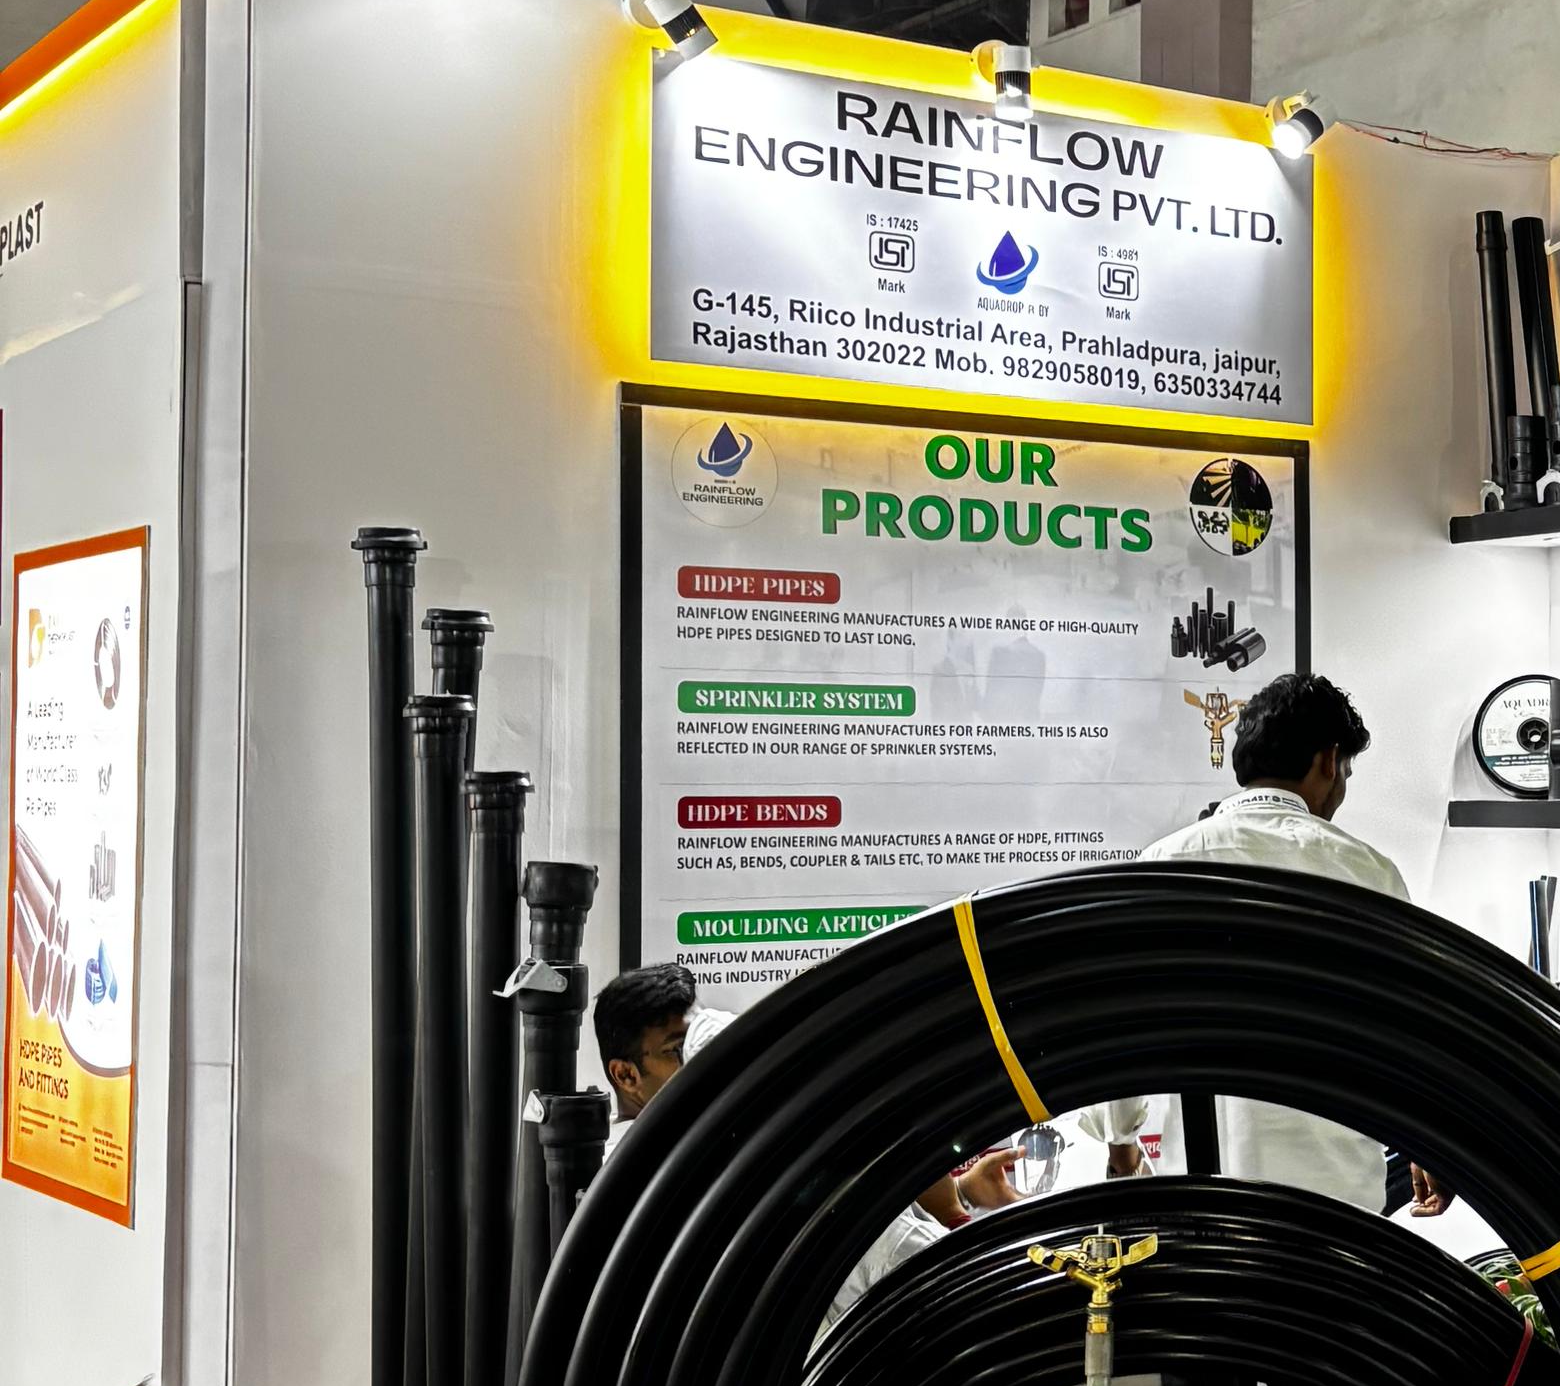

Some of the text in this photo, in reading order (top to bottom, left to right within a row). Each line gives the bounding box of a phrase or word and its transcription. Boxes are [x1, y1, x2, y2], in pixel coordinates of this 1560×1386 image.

[837, 90, 1164, 179] RAINFLOW
[695, 125, 1282, 245] ENGINEERING PVT. LTD.
[867, 214, 919, 232] IS 17425
[1098, 246, 1108, 257] IS
[878, 278, 905, 293] Mark
[977, 297, 1024, 314] AQUADROP
[1106, 306, 1131, 321] Mark
[693, 288, 1281, 379] G-145, Riico Industrial Area, Prahladpura, jaipur,
[693, 321, 1282, 405] Rajasthan 302022 Mob. 9829058019, 6350334744
[924, 434, 1057, 487] OUR
[694, 484, 756, 496] RAINFLOW
[682, 493, 764, 507] ENGINEERING
[821, 488, 1153, 553] PRODUCTS
[694, 574, 825, 597] HDPE PIPES
[677, 606, 1139, 635] RAINFLOW ENGINEERING MANUFACTURES A WIDE RANGE OF HIGH-QUALITY
[677, 625, 916, 646] HDPE PIPES DESIGNED TO LAST LONG.
[696, 689, 903, 710] SPRINKLER SYSTEM
[677, 721, 748, 734] RAINFLOW
[752, 722, 840, 735] ENGINEERING
[844, 724, 946, 737] MANUFACTURES
[949, 725, 972, 737] FOR
[1038, 726, 1063, 738] THIS
[1066, 726, 1076, 737] IS
[1079, 726, 1109, 738] ALSO
[677, 741, 749, 754] REFLECTED
[753, 742, 766, 754] IN
[770, 742, 799, 755] OUR
[803, 743, 847, 755] RANGE
[850, 743, 867, 755] OF
[871, 743, 936, 755] SPRINKLER
[688, 804, 828, 822] HDPE BENDS
[678, 831, 1104, 850] RAINFLOW ENGINEERING MANUFACTURES A RANGE OF HDPE, FITTINGS
[677, 857, 712, 870] SUCH
[716, 857, 736, 871] AS,
[740, 856, 786, 869] BENDS,
[790, 855, 847, 868] COUPLER
[850, 854, 860, 866] &
[864, 854, 896, 866] TAILS
[927, 853, 943, 864] TO
[946, 852, 981, 864] MAKE
[984, 851, 1005, 863] THE
[1009, 851, 1058, 863] PROCESS
[1061, 851, 1076, 862] OF
[693, 916, 809, 937] MOULDING
[677, 951, 747, 965] RAINFLOW
[726, 969, 791, 984] INDUSTRY
[19, 1067, 69, 1099] AND FITTINGS
